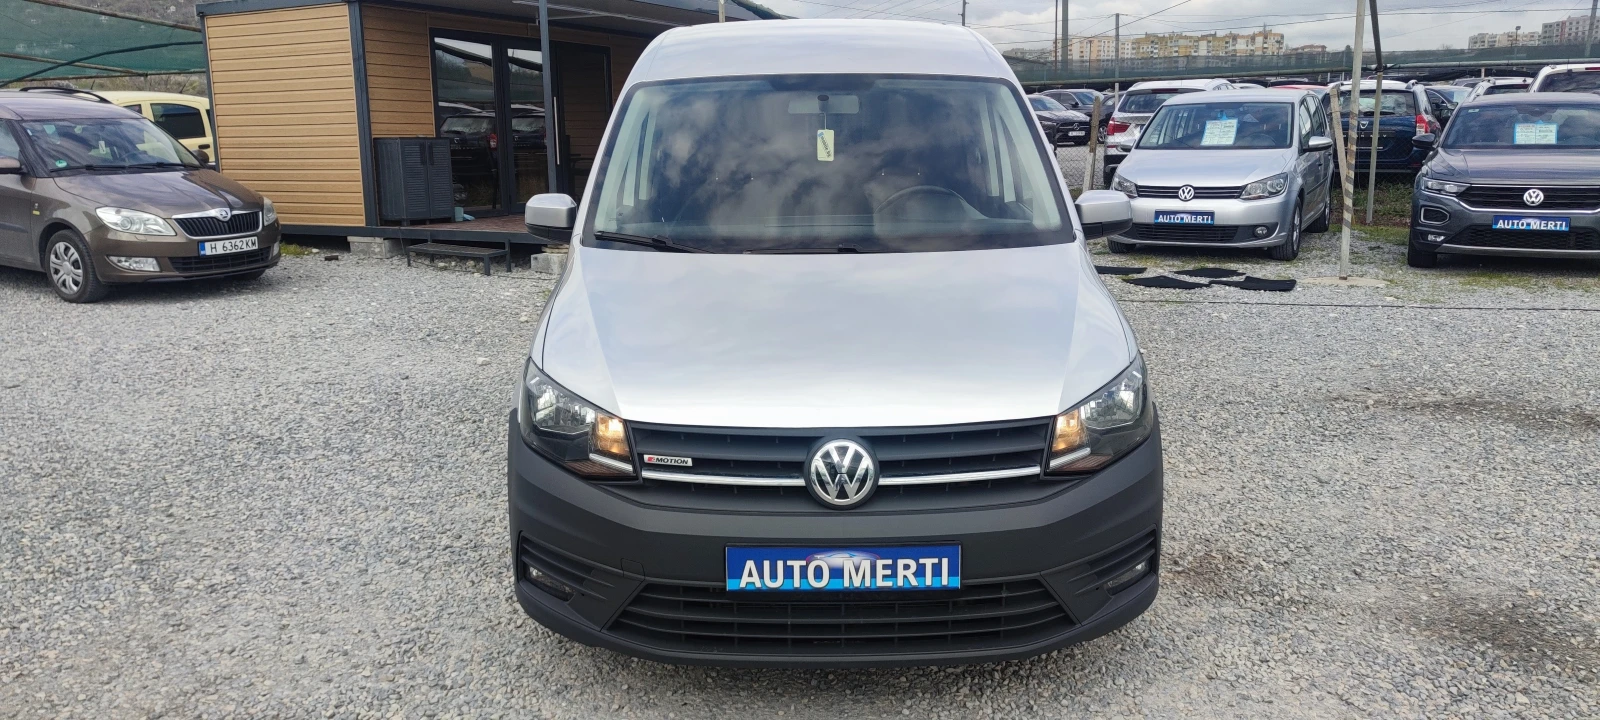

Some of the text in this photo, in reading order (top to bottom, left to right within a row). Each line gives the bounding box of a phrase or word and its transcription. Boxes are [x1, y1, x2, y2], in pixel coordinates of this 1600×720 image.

[1157, 214, 1211, 224] AUTO MERTI
[1496, 219, 1566, 231] AUTO MERTI
[210, 242, 218, 253] H
[810, 438, 876, 505] VW
[739, 557, 949, 588] AUTO MERTI
